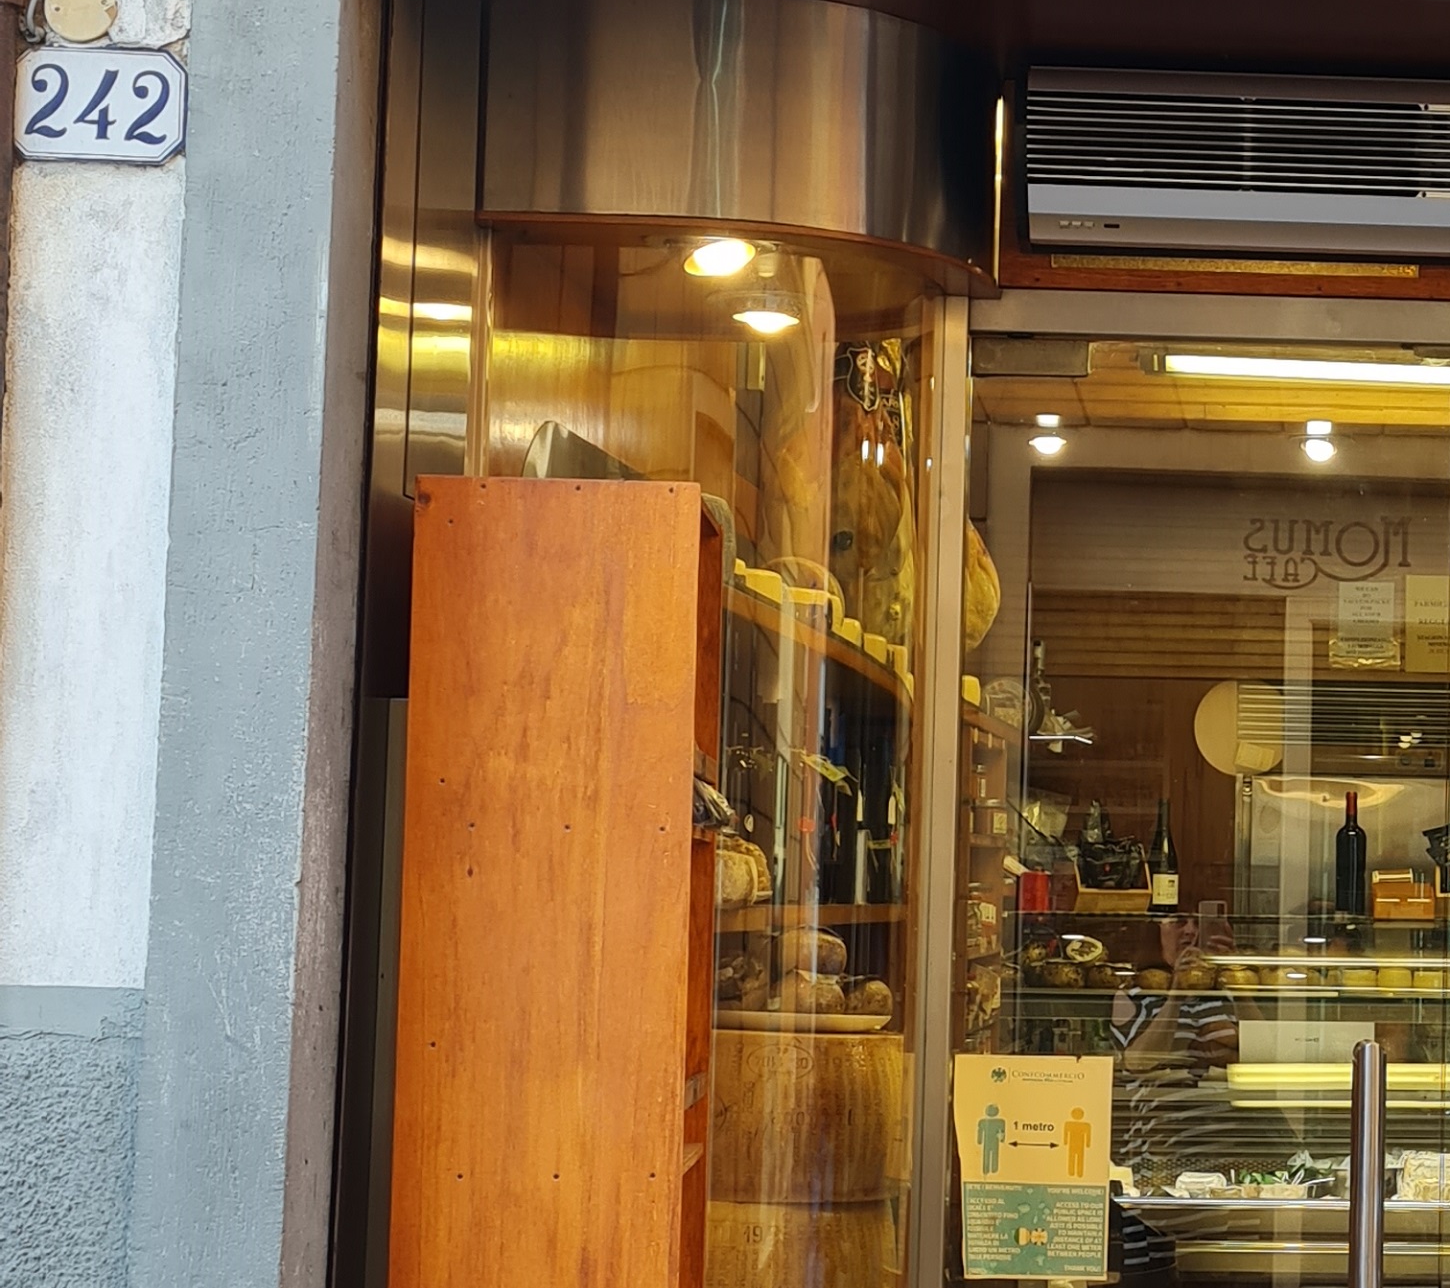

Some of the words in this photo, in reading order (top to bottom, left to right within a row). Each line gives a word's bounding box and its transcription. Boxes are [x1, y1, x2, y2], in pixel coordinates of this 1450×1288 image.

[24, 63, 170, 145] 242
[1011, 1069, 1085, 1080] CONFCOMMERCIO
[1013, 1121, 1019, 1130] 1
[1022, 1122, 1055, 1132] metro
